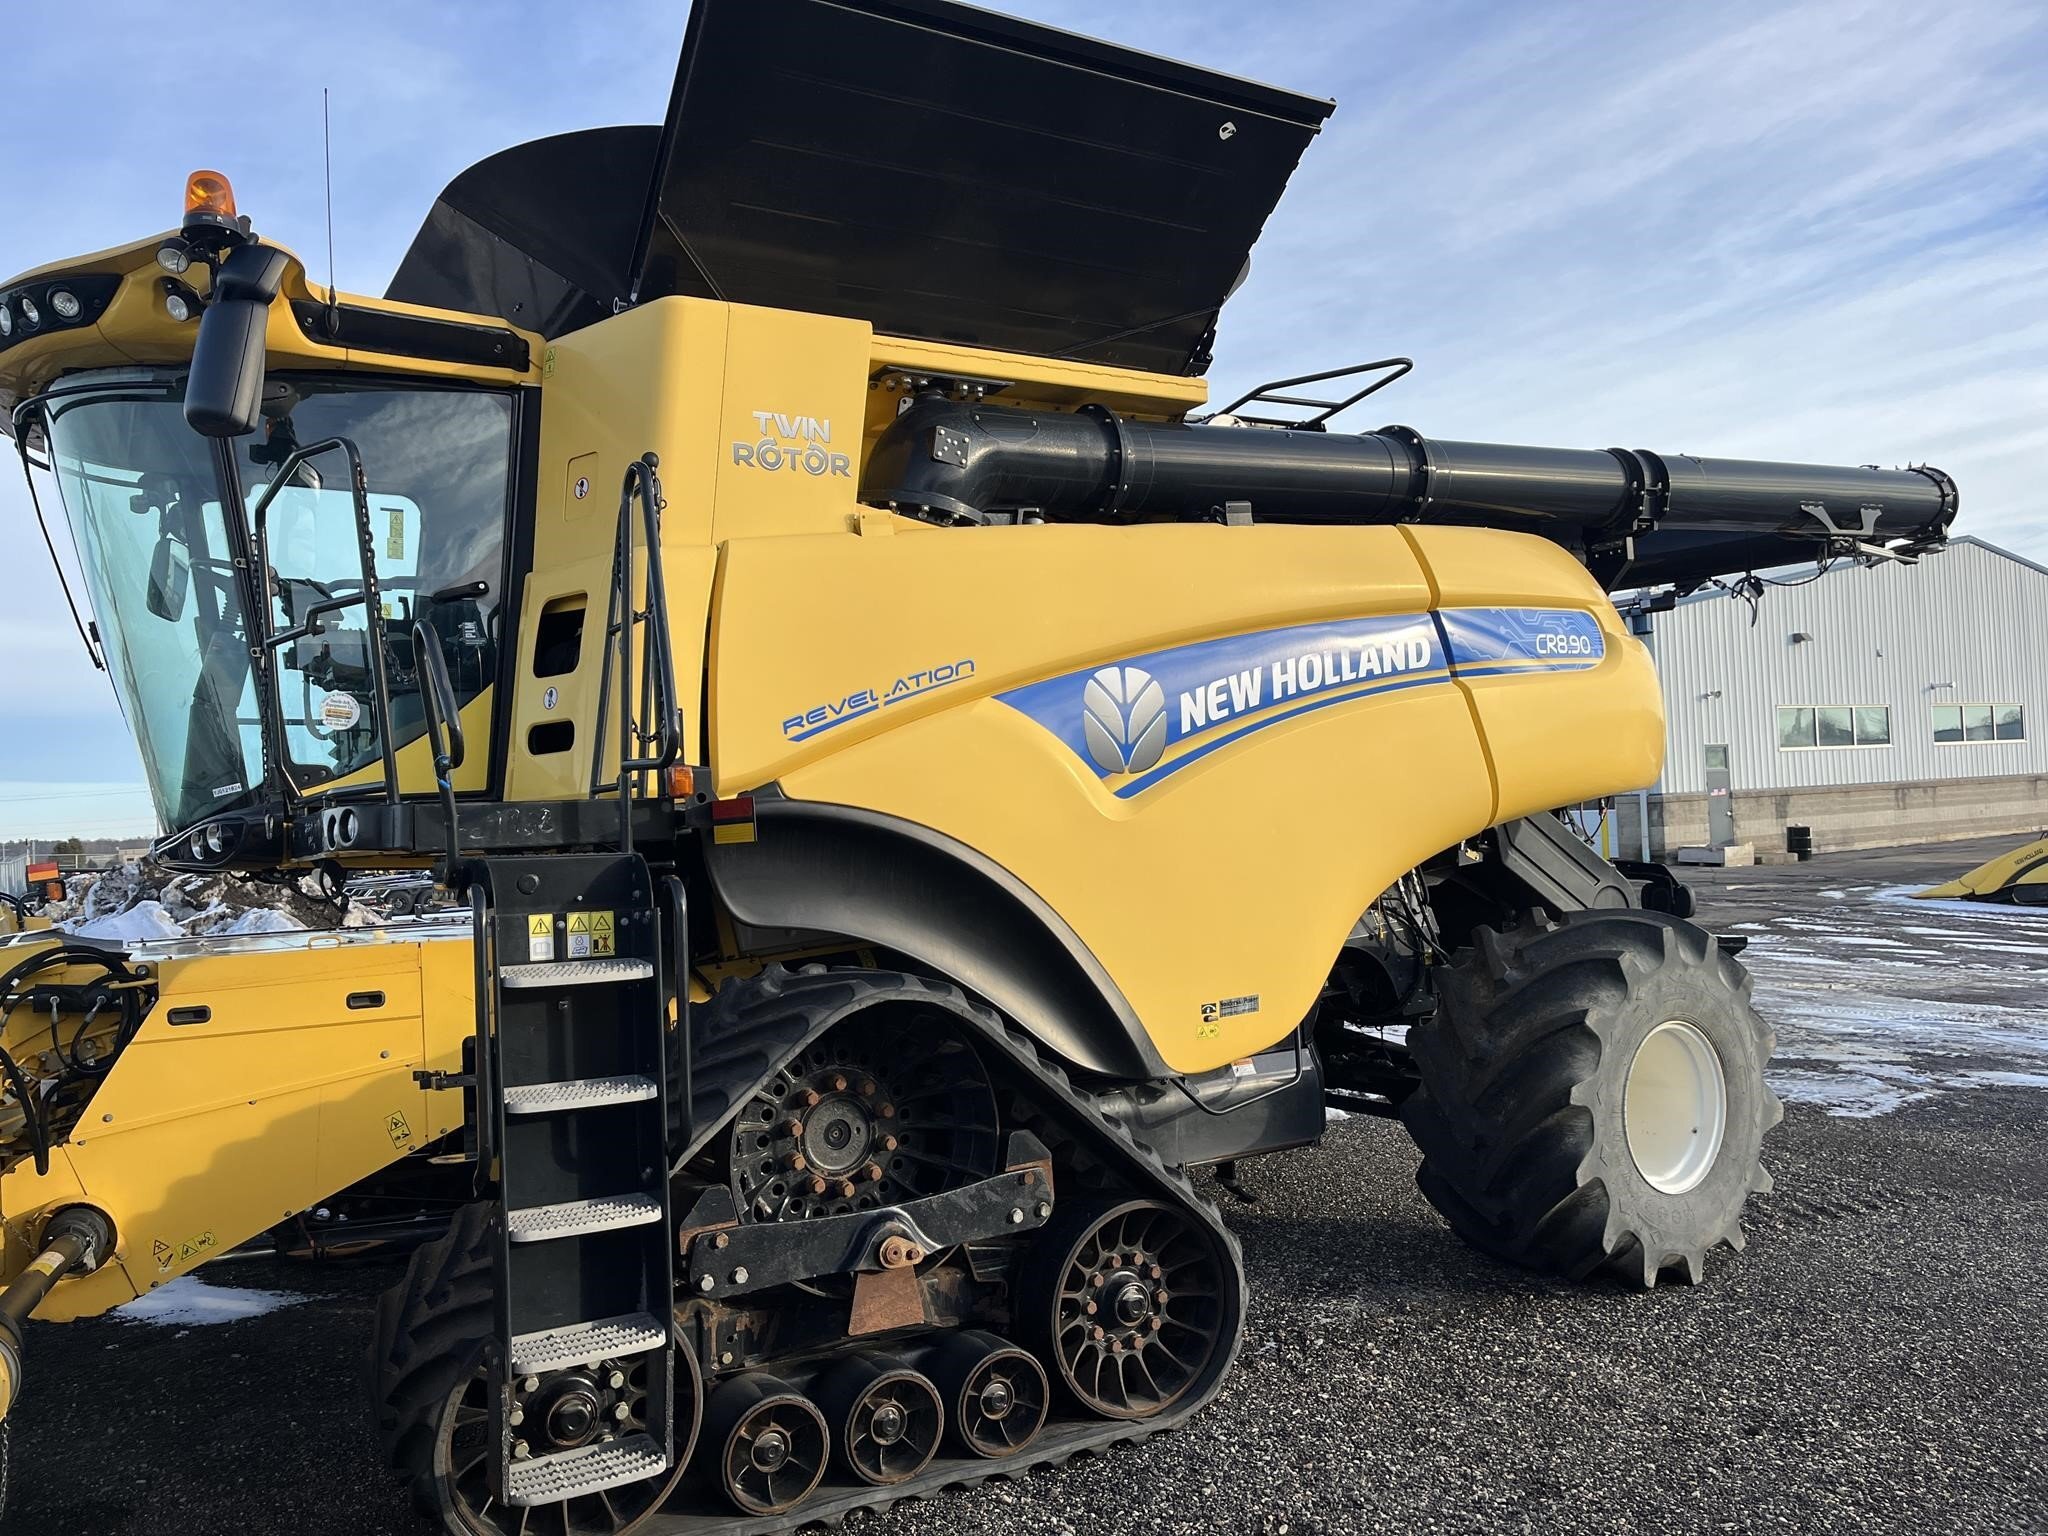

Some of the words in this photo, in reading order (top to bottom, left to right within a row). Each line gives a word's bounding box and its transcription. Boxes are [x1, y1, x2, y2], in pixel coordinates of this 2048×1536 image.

[752, 410, 831, 443] TWIN
[732, 437, 852, 478] ROTOR
[1535, 633, 1591, 655] CR8.90
[782, 658, 975, 735] REVELATION
[1179, 666, 1263, 735] NEW
[1272, 635, 1432, 701] HOLLAND
